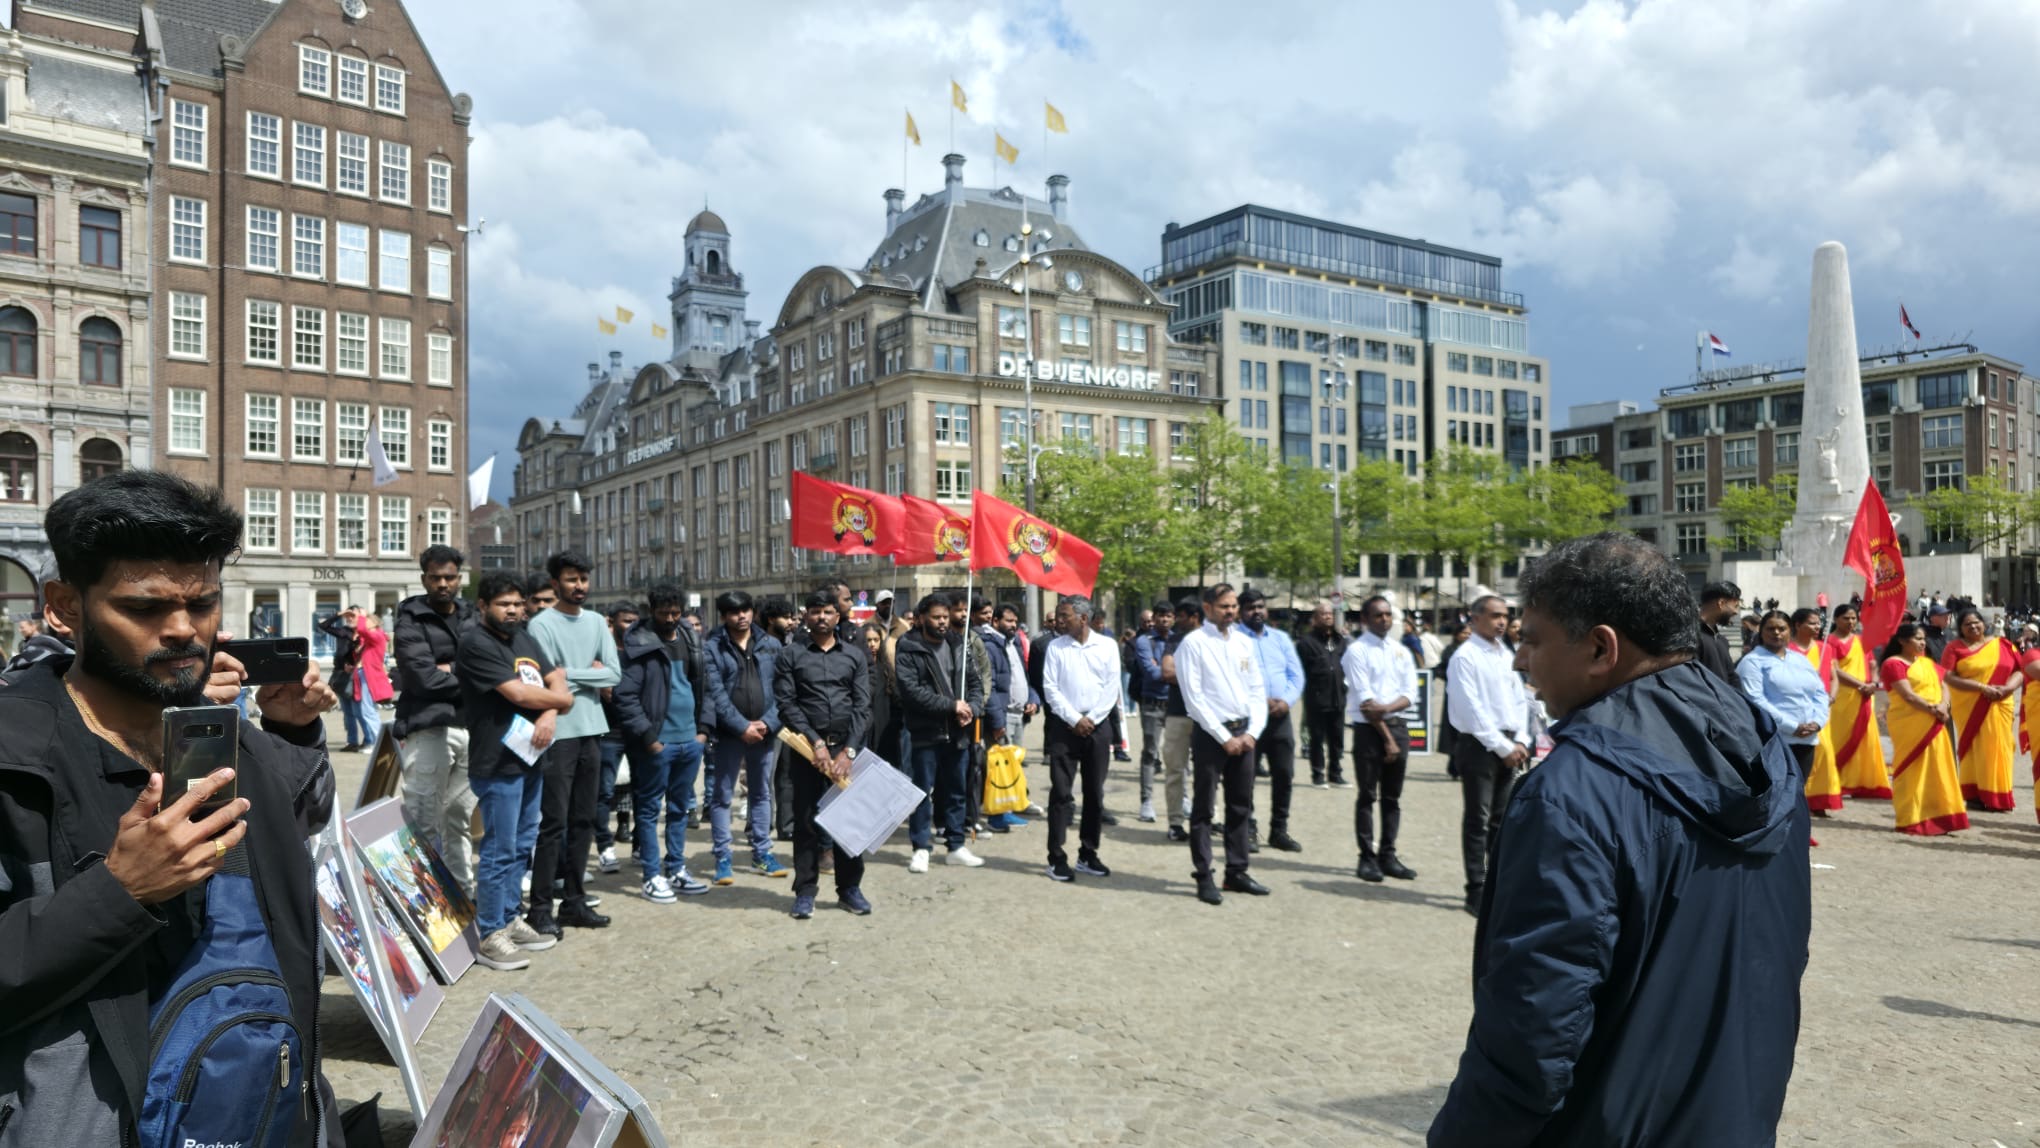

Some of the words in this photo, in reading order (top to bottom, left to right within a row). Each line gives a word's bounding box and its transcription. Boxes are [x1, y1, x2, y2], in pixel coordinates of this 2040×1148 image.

[999, 356, 1031, 378] DE
[1037, 360, 1161, 390] BIJENKORF
[312, 568, 346, 580] DIOR
